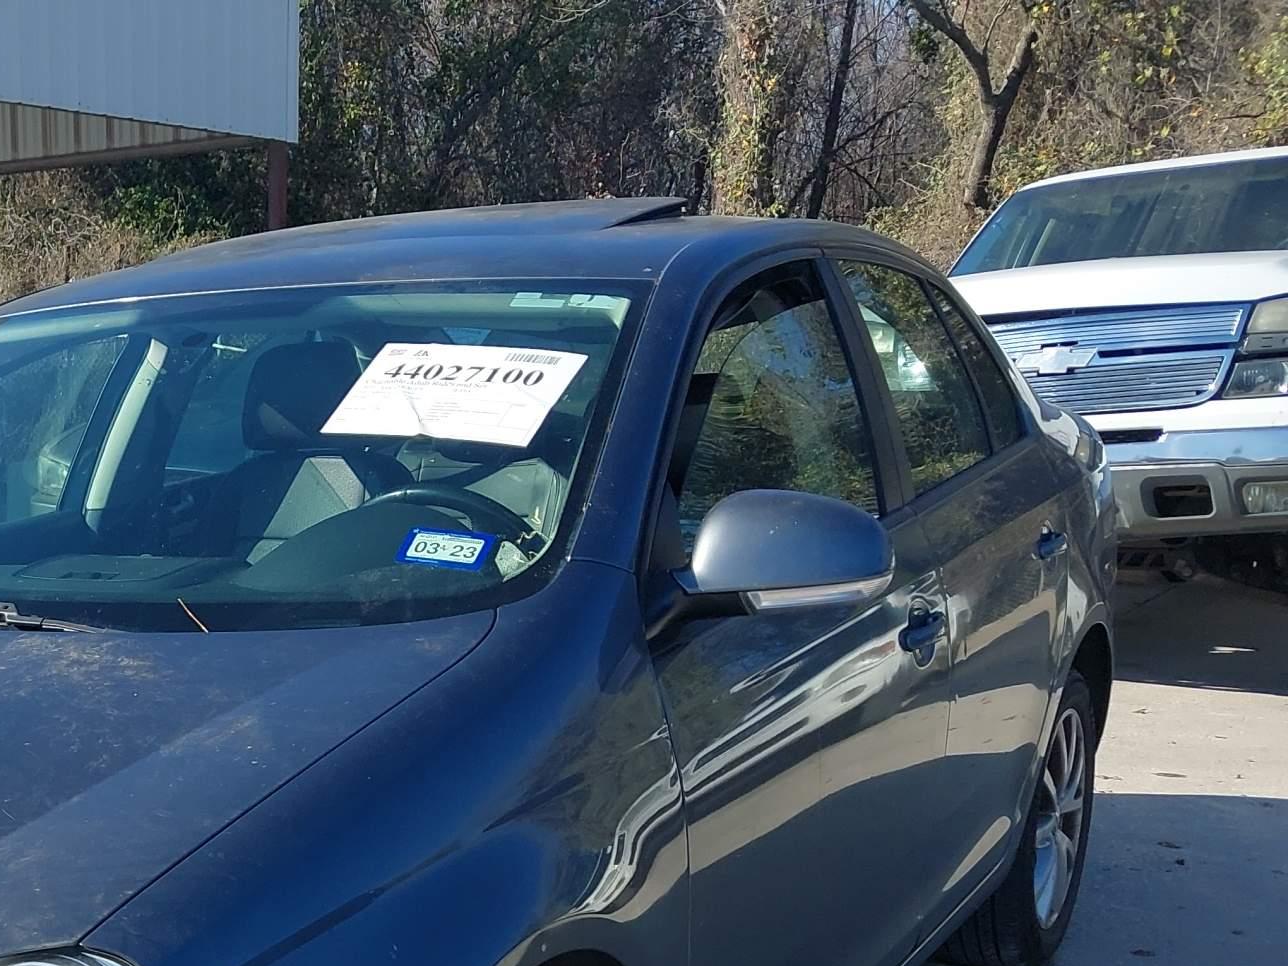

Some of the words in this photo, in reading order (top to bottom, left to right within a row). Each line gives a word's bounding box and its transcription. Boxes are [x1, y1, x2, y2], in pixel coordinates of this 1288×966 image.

[384, 364, 545, 387] 44027100
[414, 541, 440, 554] 03
[449, 545, 477, 558] 23
